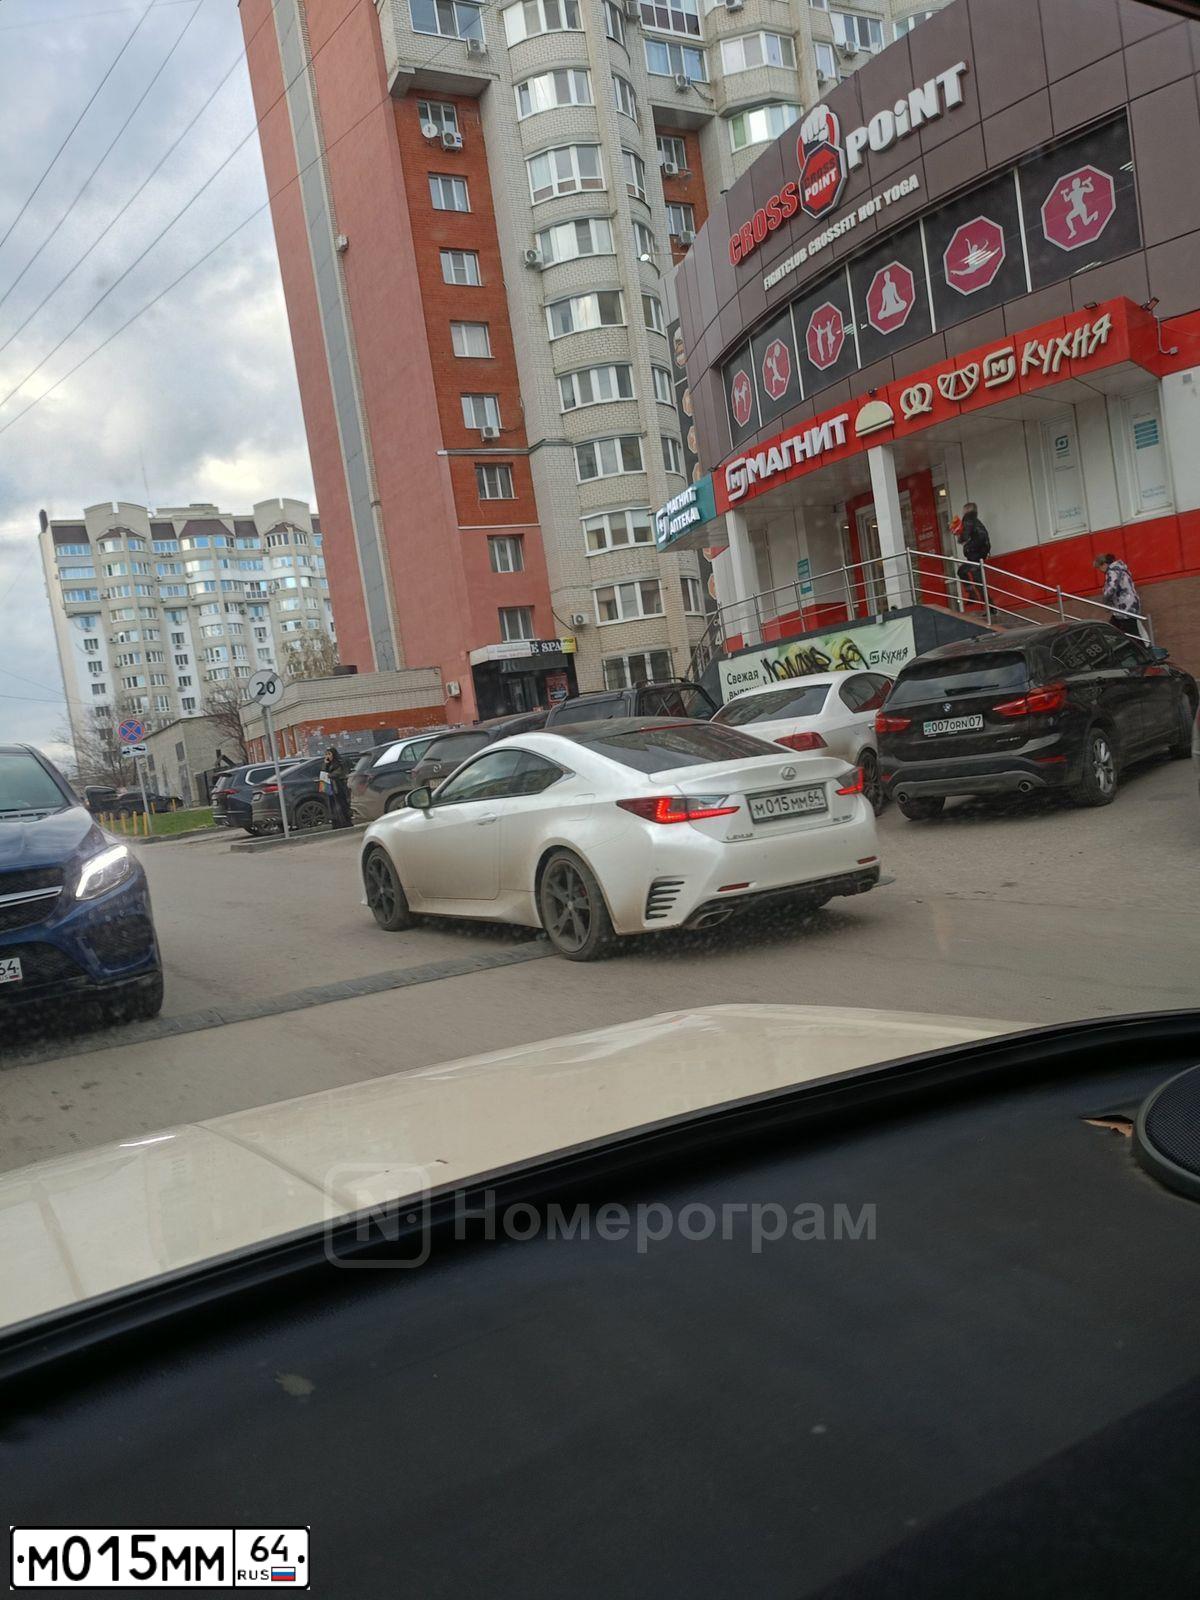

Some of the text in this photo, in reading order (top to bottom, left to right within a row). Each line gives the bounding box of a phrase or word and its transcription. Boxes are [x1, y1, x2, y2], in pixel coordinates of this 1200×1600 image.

[728, 182, 798, 267] CROSS
[808, 211, 857, 256] CROSSFIT
[857, 195, 884, 222] HOT
[882, 173, 920, 206] YOGA
[1021, 313, 1113, 377] КУХНЯ
[746, 413, 849, 485] МАГНИТ
[666, 486, 697, 516] МАГНИТ
[669, 507, 701, 536] АПТЕКА
[880, 646, 908, 664] КУХНЯ
[256, 681, 276, 696] 20
[726, 670, 759, 686] Свежая
